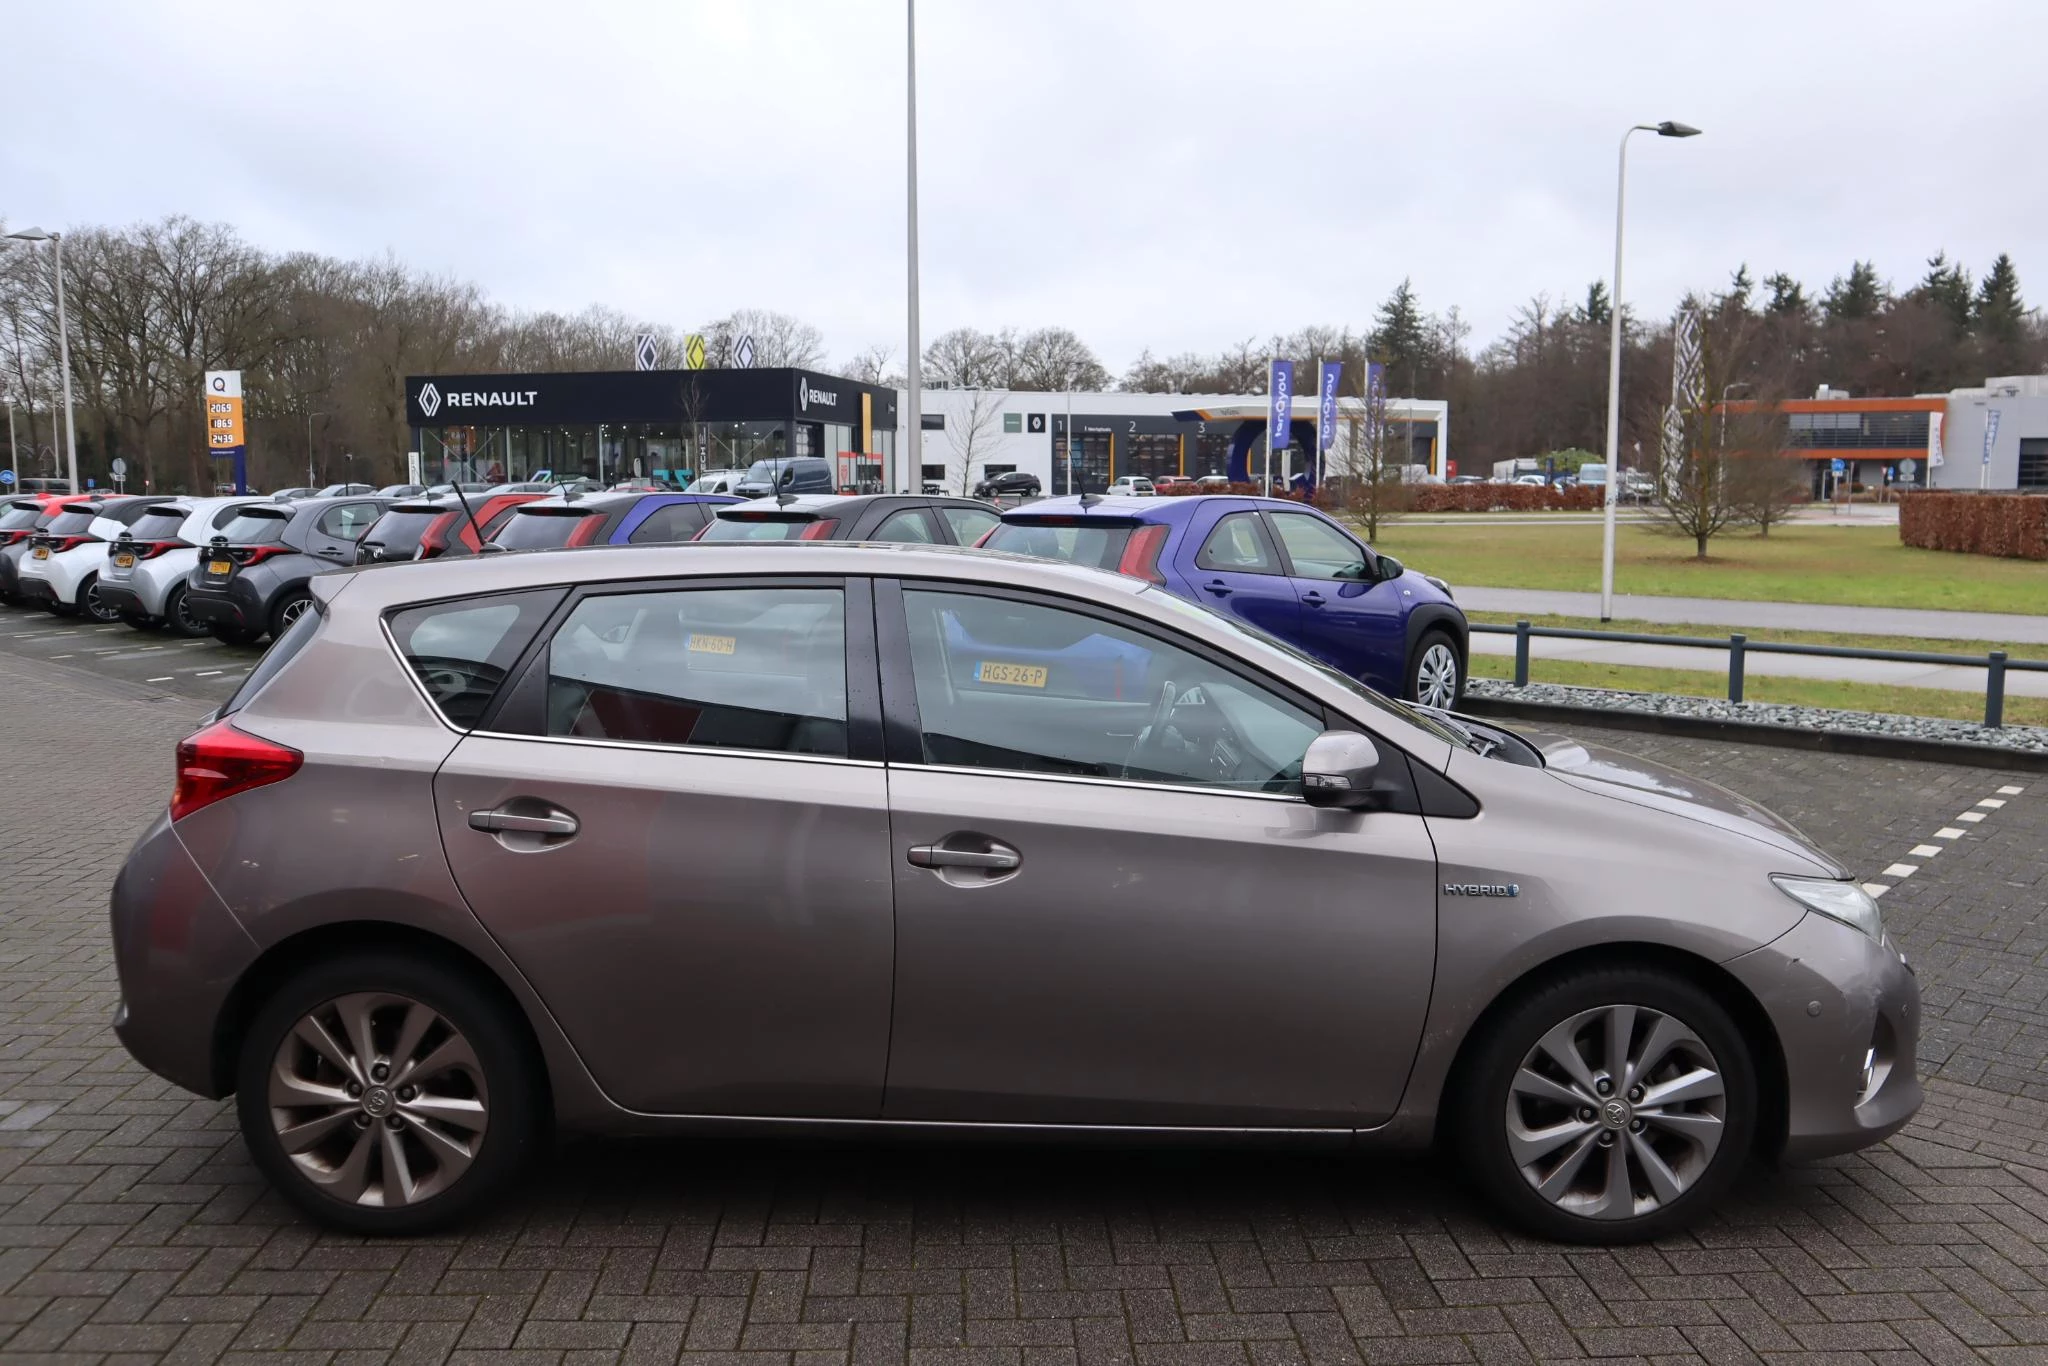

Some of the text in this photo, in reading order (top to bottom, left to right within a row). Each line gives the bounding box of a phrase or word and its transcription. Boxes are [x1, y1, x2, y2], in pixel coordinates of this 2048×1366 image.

[447, 391, 538, 407] RENAULT
[809, 389, 837, 406] RENAULT
[1129, 421, 1136, 432] 2
[1198, 421, 1206, 433] 3
[982, 664, 1043, 684] HGS-26-P
[1444, 883, 1507, 897] HYBRID
